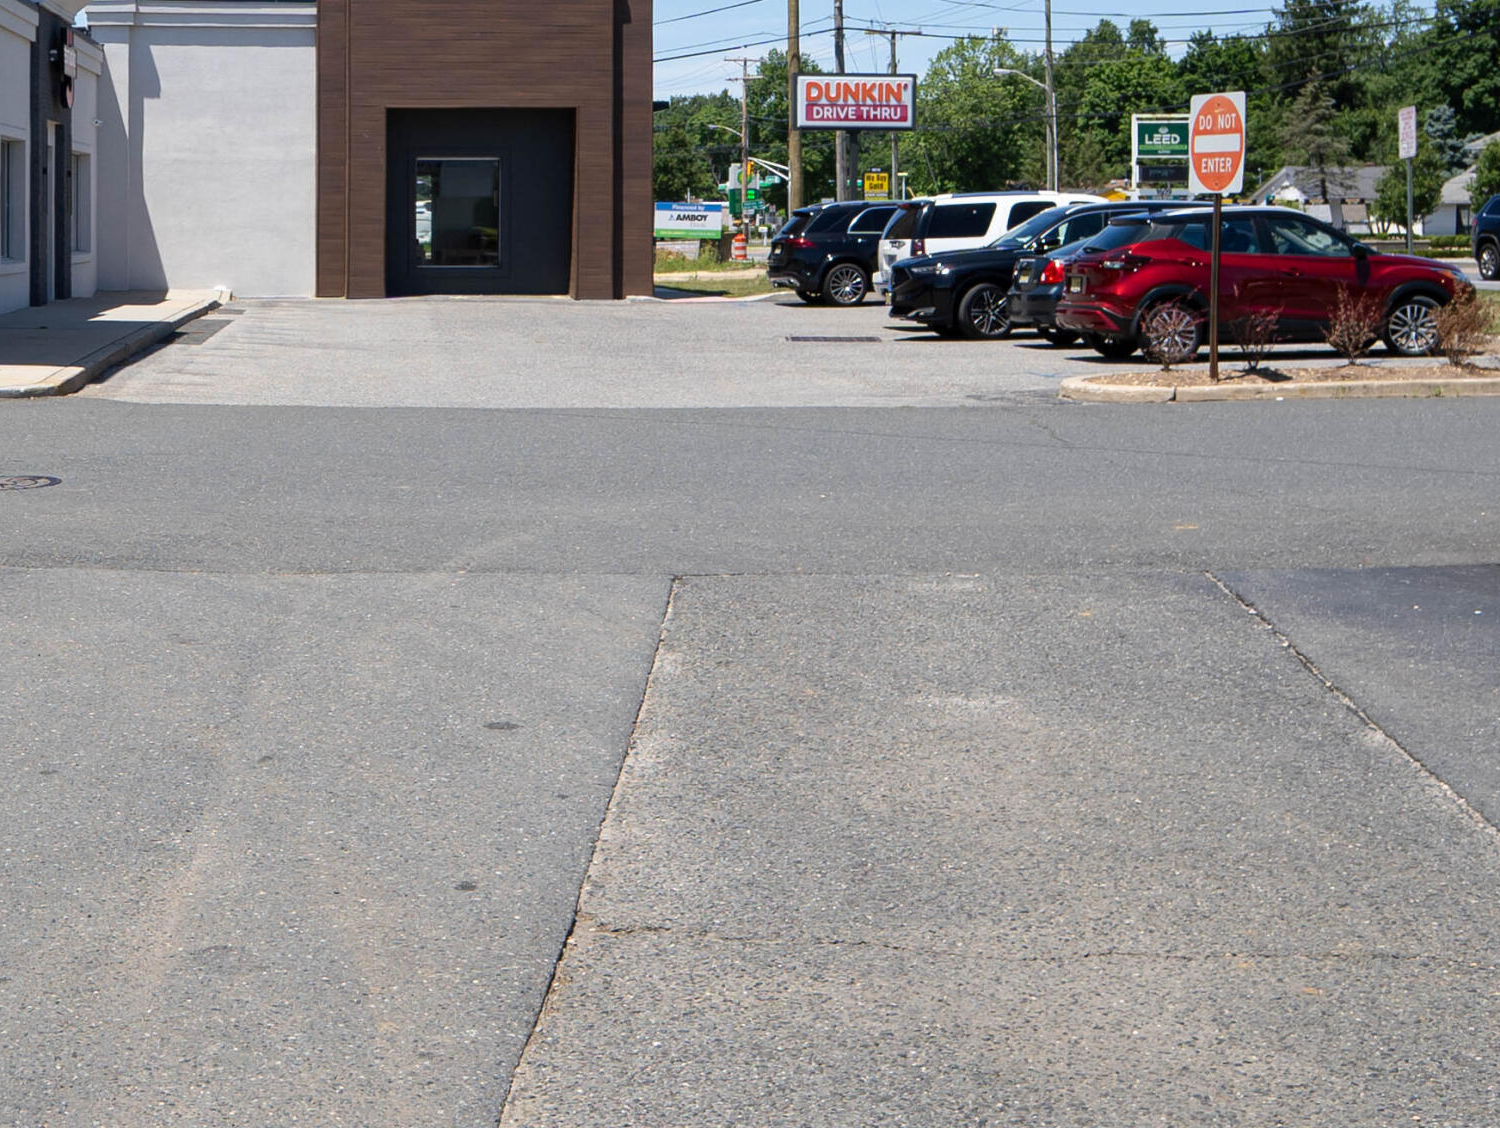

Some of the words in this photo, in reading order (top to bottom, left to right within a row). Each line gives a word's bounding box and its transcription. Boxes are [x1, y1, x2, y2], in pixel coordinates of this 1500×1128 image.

[806, 82, 908, 103] DUNKIN'
[813, 106, 856, 119] DRIVE
[860, 106, 900, 119] THRU
[1198, 114, 1213, 131] DO
[1217, 112, 1237, 129] NOT
[1144, 133, 1181, 145] LEED
[1201, 157, 1233, 173] ENTER
[676, 213, 708, 222] AMBOY
